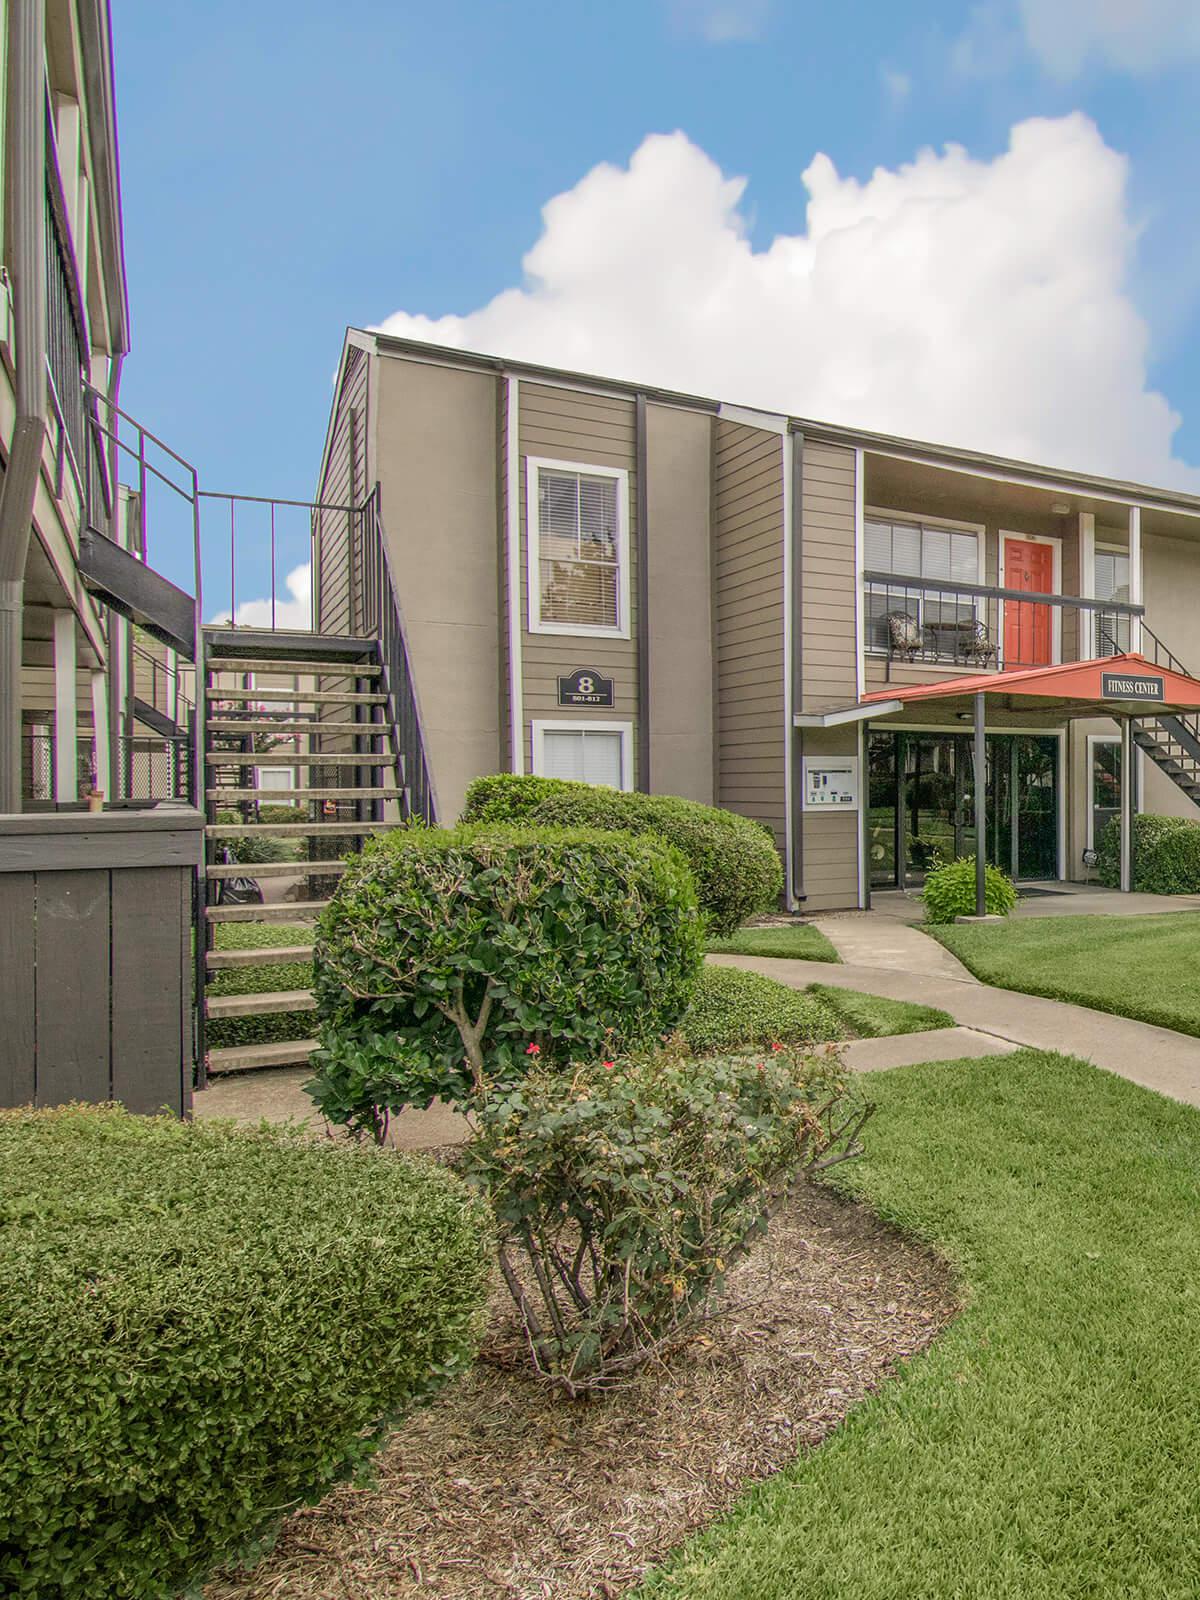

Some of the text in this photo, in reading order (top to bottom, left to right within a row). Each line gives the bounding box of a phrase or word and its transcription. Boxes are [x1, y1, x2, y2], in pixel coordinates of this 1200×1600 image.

[578, 677, 594, 693] 8
[1108, 680, 1159, 695] FITNESS CENTER
